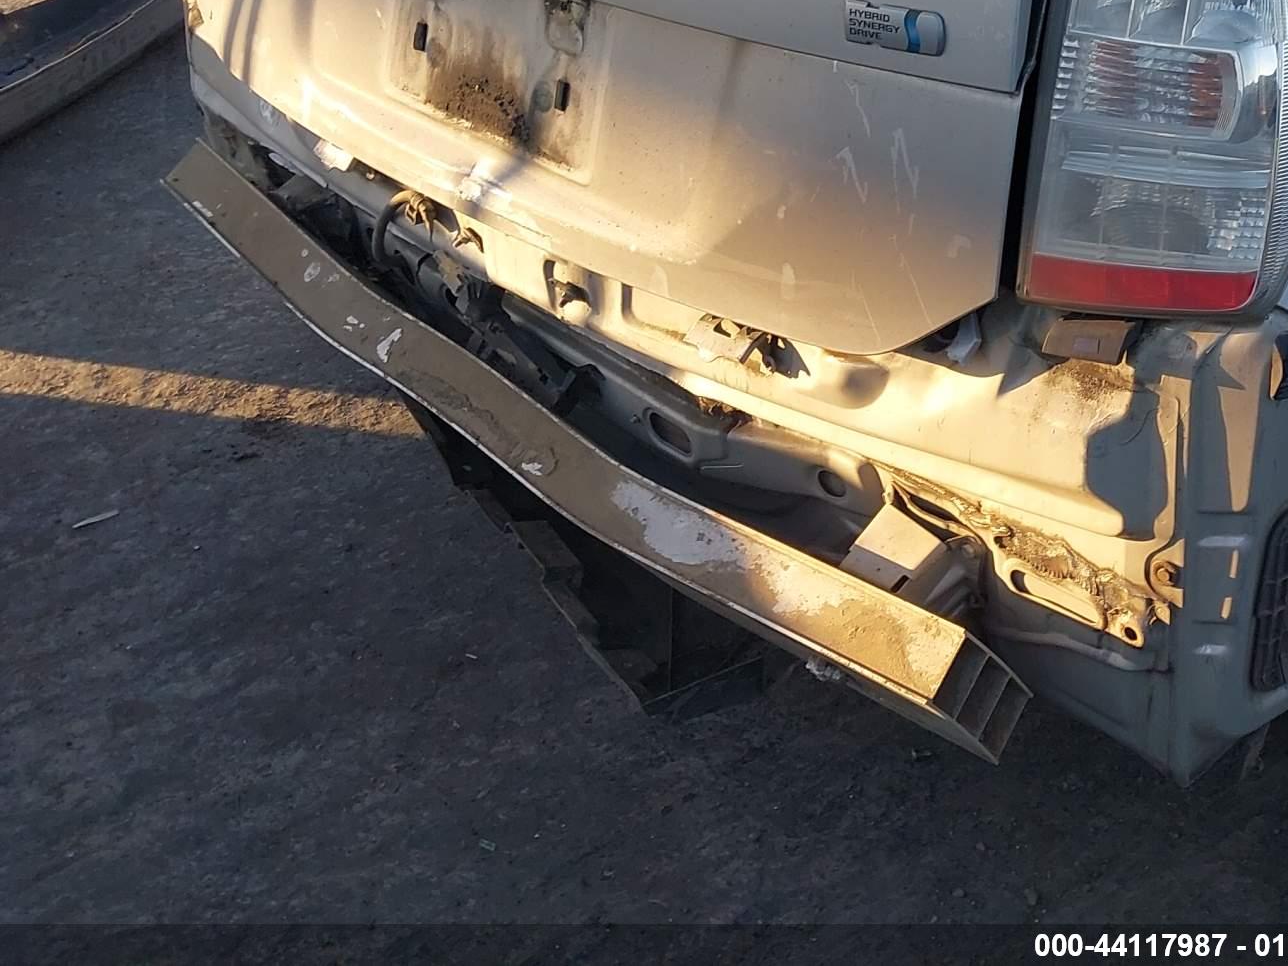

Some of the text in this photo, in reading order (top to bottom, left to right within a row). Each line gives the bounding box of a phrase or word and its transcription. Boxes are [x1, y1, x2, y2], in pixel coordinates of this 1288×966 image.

[849, 8, 890, 23] HYBRID
[849, 18, 900, 34] SYNERGY
[849, 27, 883, 40] DRIVE
